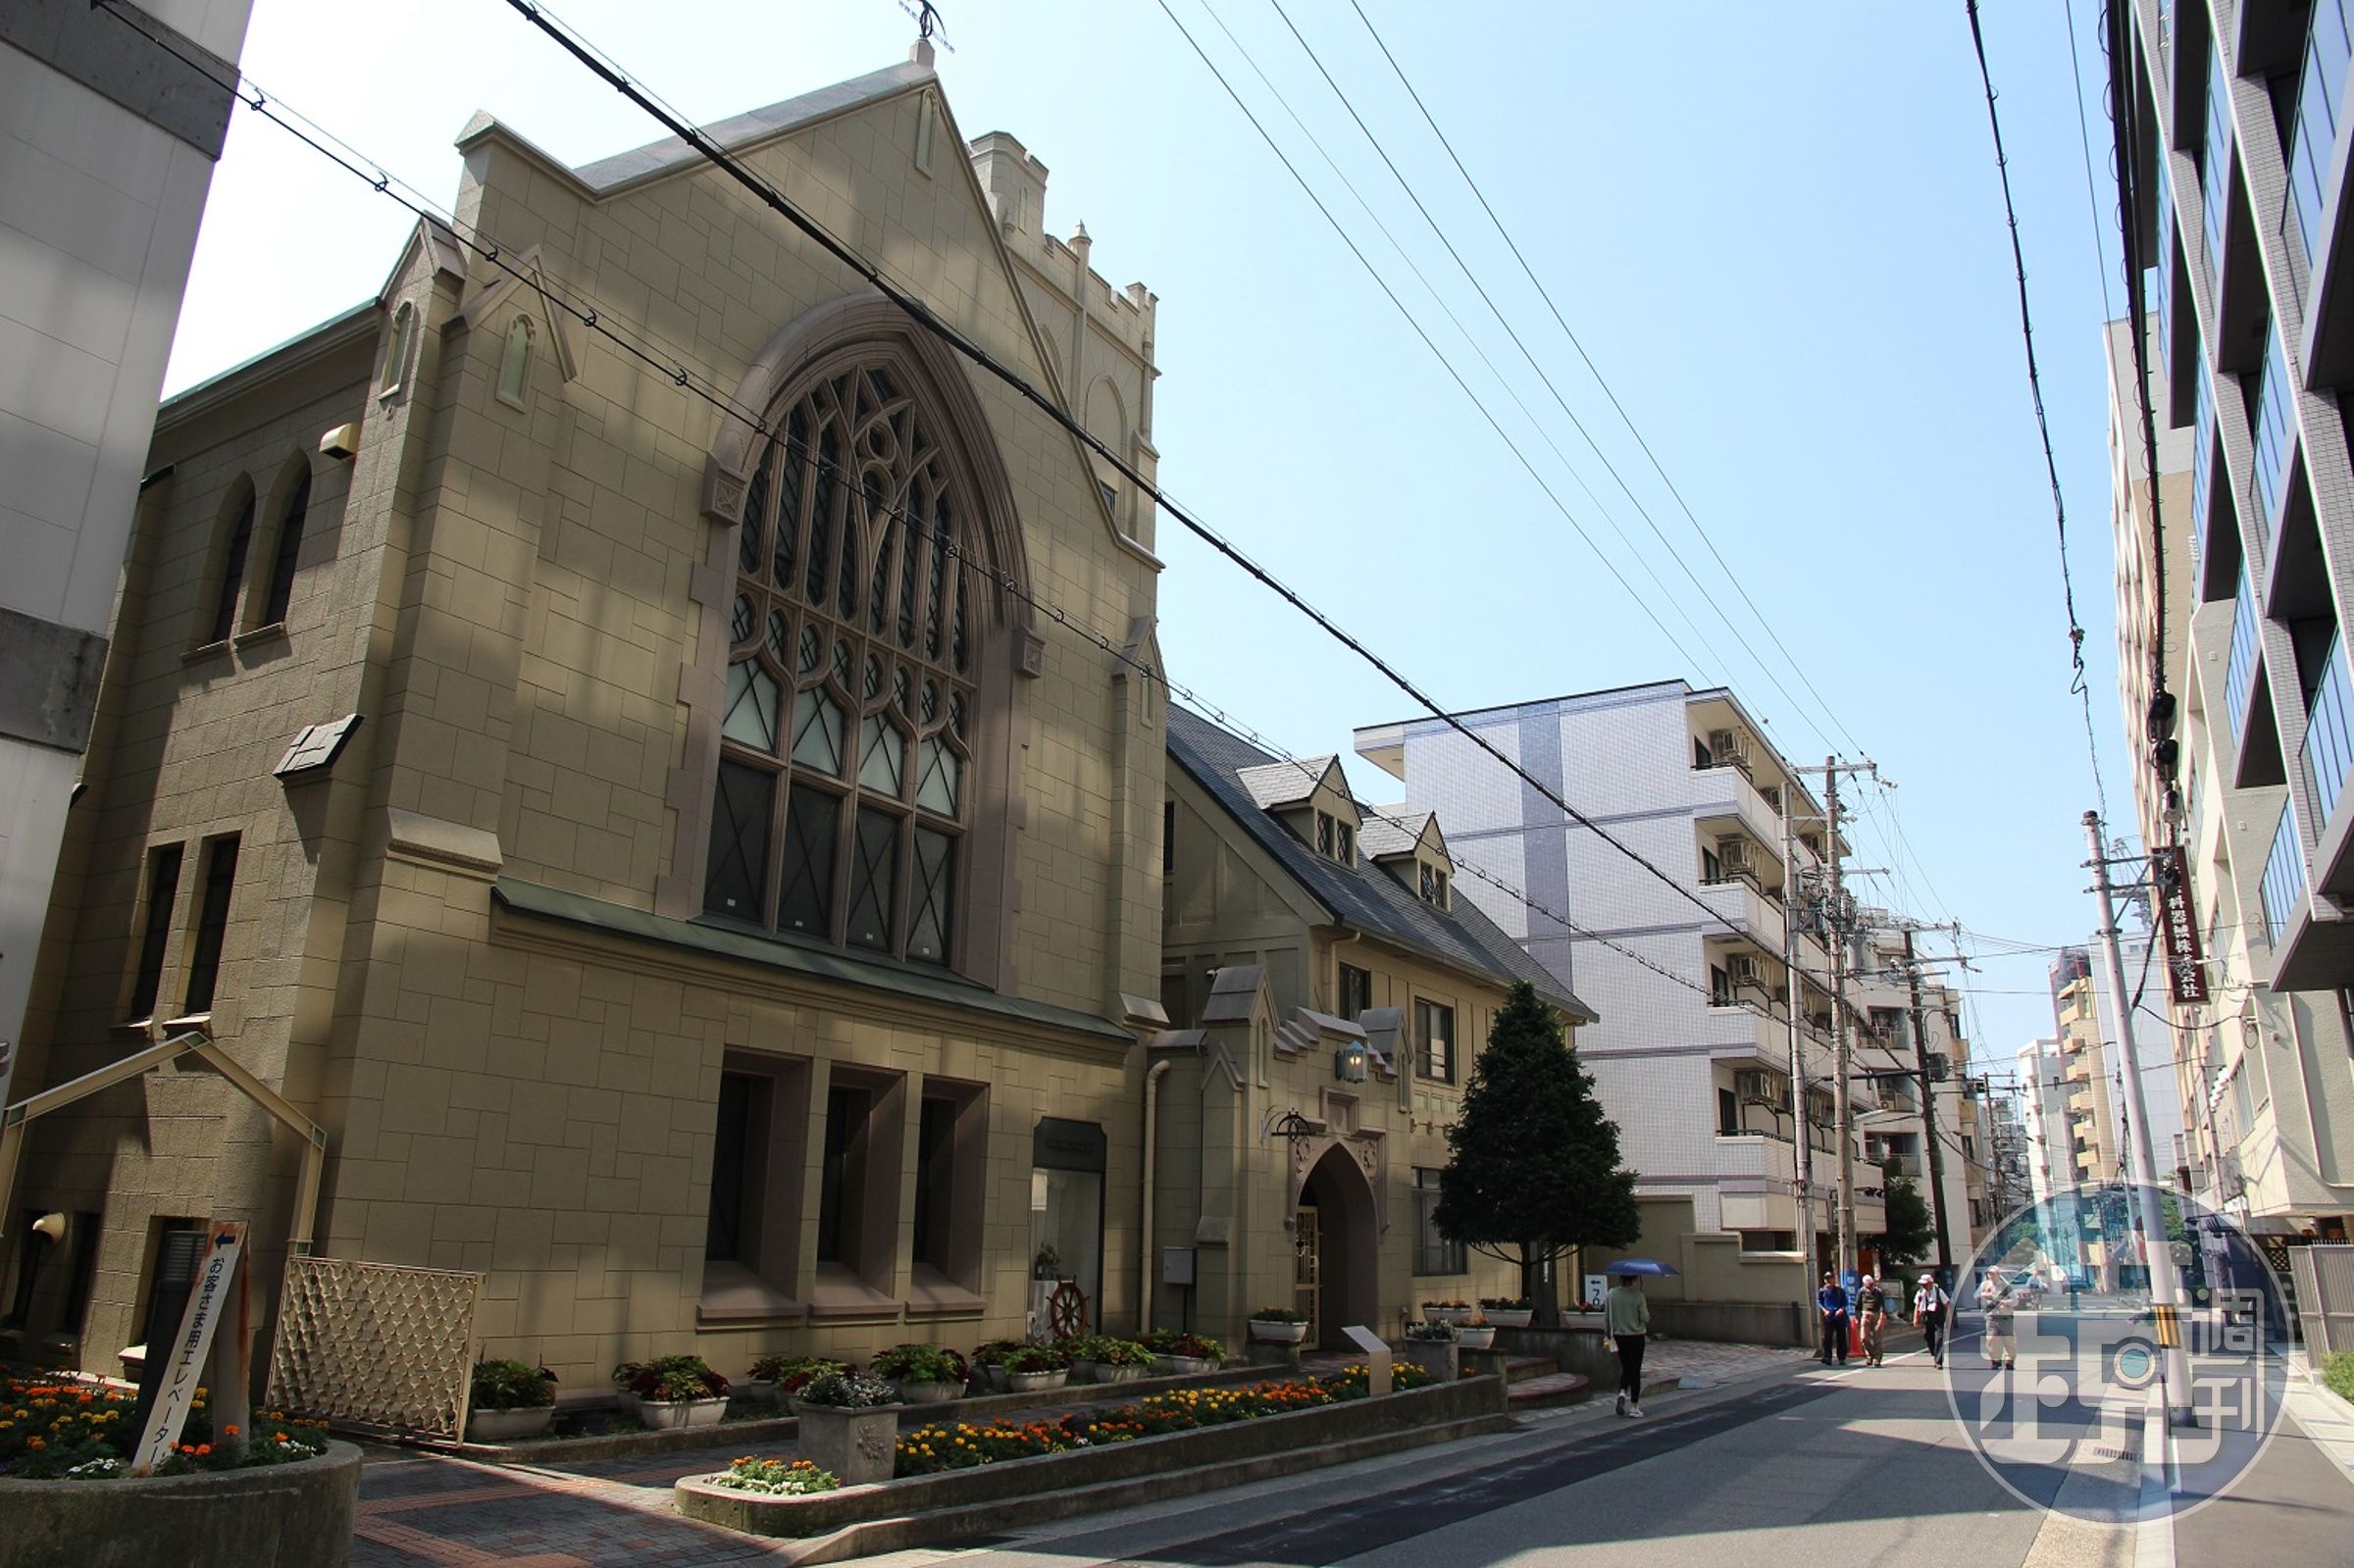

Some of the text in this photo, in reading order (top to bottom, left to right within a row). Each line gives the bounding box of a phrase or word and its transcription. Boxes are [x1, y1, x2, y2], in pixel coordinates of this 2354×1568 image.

[148, 1256, 223, 1463] お客さま用エレベーター
